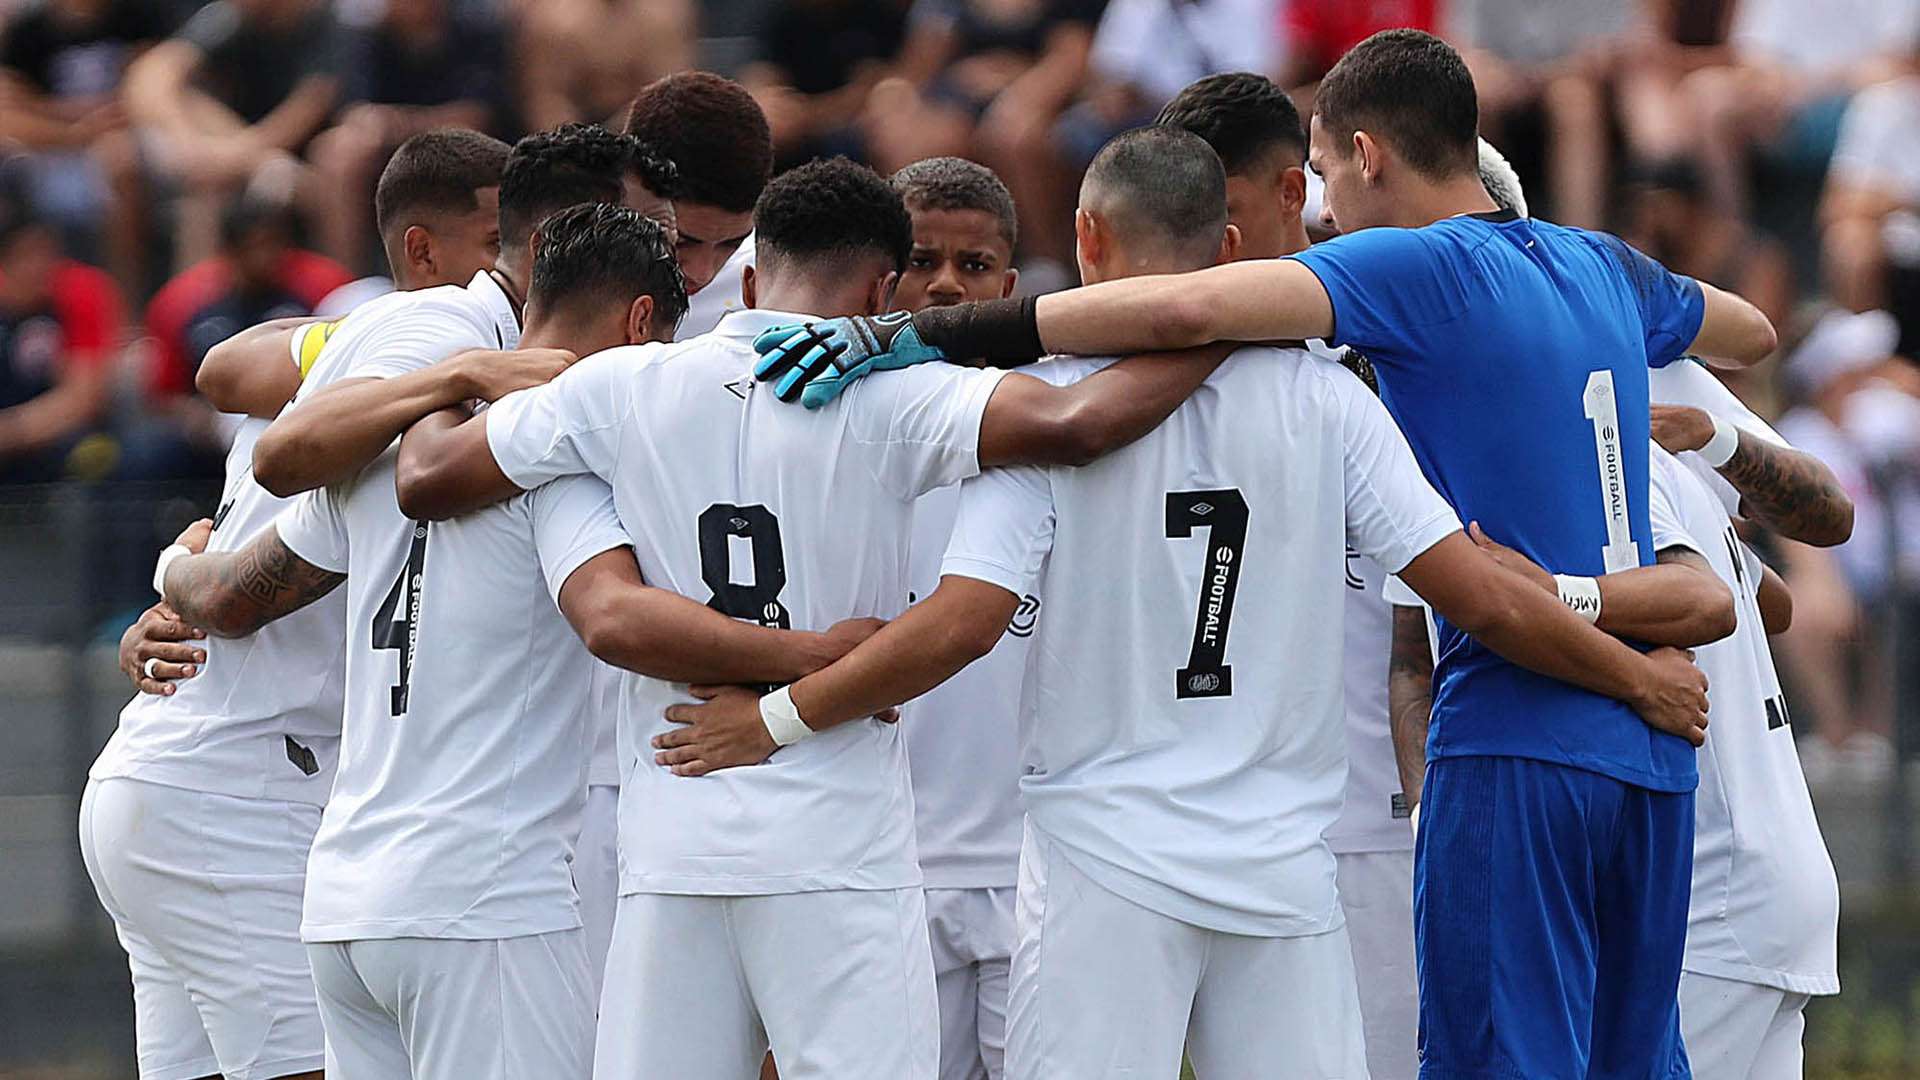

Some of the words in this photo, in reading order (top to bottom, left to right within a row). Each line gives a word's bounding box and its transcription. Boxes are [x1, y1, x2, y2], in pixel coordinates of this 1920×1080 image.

[1583, 370, 1640, 574] 1
[372, 519, 430, 717] 4
[1165, 488, 1250, 699] 7
